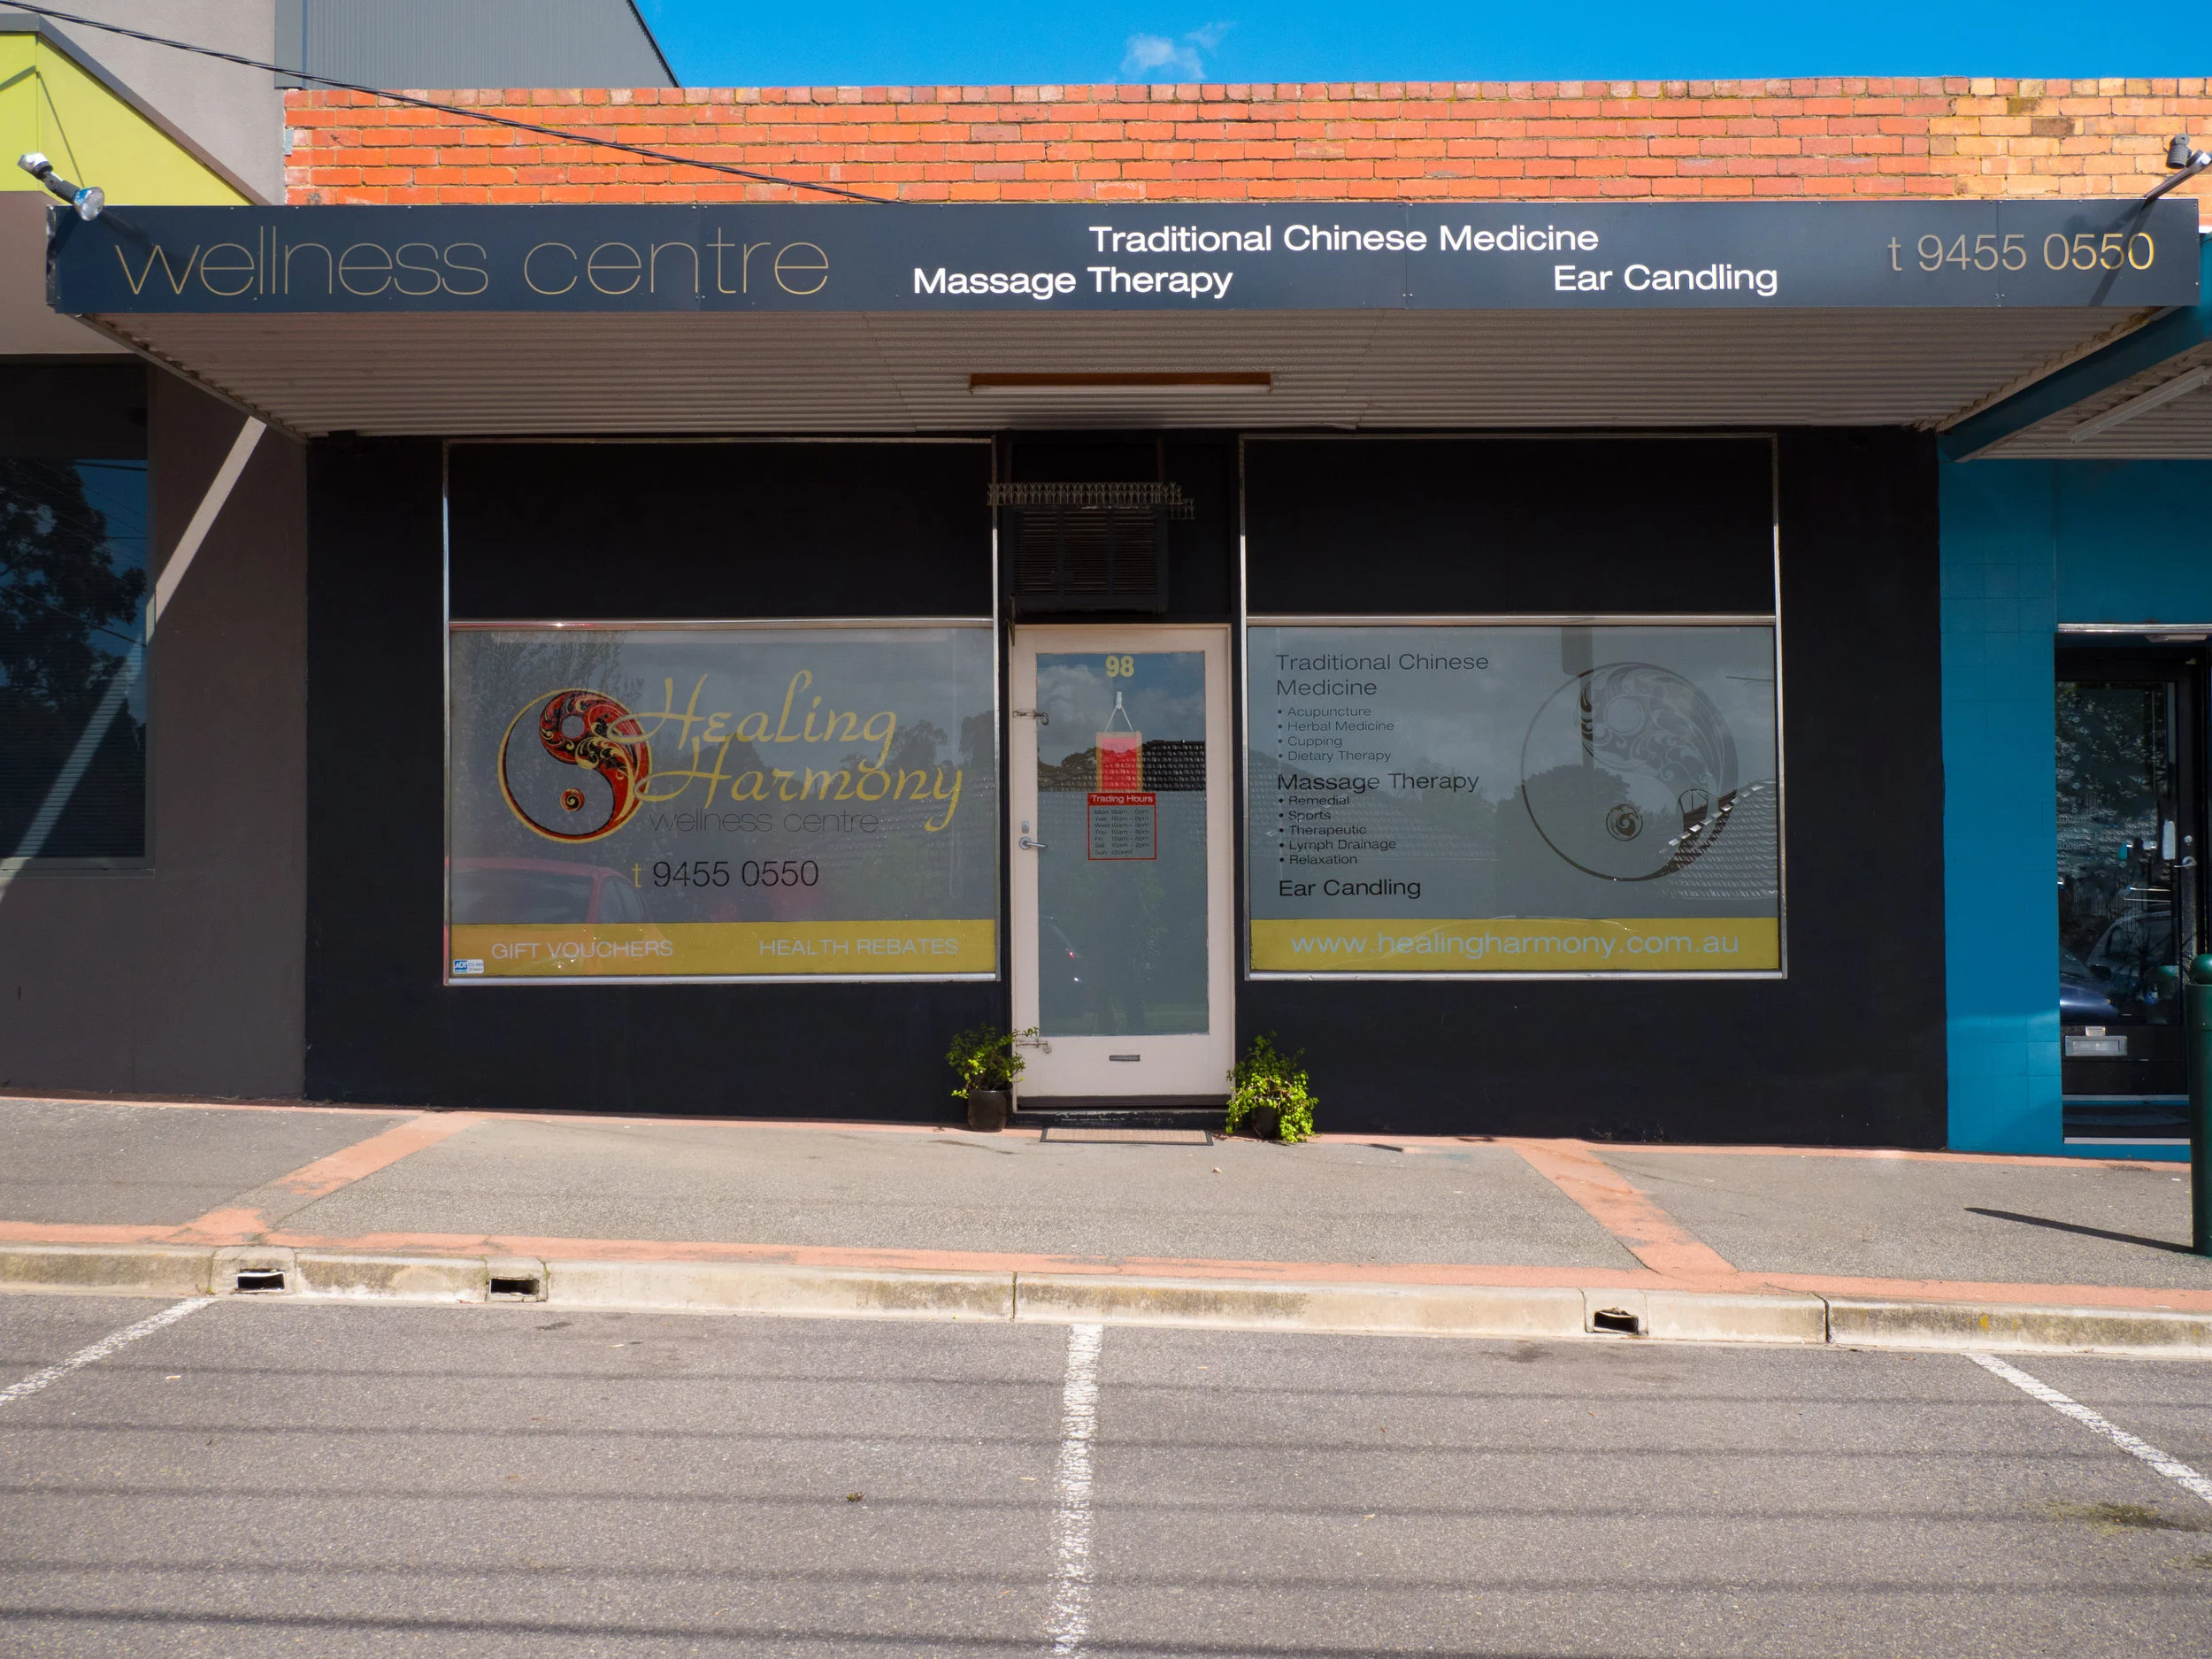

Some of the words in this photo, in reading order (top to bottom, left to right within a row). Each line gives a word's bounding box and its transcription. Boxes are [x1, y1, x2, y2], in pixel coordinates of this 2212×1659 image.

[1088, 224, 1271, 253] Traditional
[1283, 224, 1428, 252] Chinese
[1439, 224, 1599, 251] Medicine
[114, 225, 489, 296] wellness
[523, 226, 830, 296] centre
[1886, 235, 1902, 272] t
[1916, 233, 2028, 272] 9455
[2041, 233, 2155, 272] 0550
[912, 267, 1077, 300] Massage
[1087, 266, 1233, 299] Therapy
[1554, 265, 1613, 292] Ear
[1623, 263, 1778, 297] Candling
[1105, 655, 1134, 678] 98
[1275, 653, 1392, 671] Traditional
[1398, 652, 1489, 671] Chinese
[1276, 678, 1378, 696] Medicine
[607, 668, 897, 774] Healing
[1287, 706, 1371, 718] Acupuncture
[1287, 720, 1331, 731] Herbal
[1333, 720, 1394, 731] Medicine
[1287, 735, 1343, 749] Cupping
[1287, 750, 1333, 763] Dietary
[1338, 749, 1392, 763] Therapy
[634, 733, 964, 833] Harmony
[1277, 773, 1380, 794] Massage
[1387, 772, 1479, 793] Therapy
[1091, 795, 1125, 804] Trading
[1288, 795, 1349, 805] Remedial
[649, 808, 772, 833] wellness
[783, 809, 879, 833] centre
[1288, 810, 1332, 823] Sports
[1288, 825, 1367, 837] Therapeutic
[1289, 839, 1334, 852] Lymph
[1337, 839, 1396, 851] Drainage
[1289, 854, 1357, 864] Relaxation
[631, 862, 642, 888] t
[652, 859, 730, 888] 9455
[741, 859, 819, 887] 0550
[1279, 879, 1316, 897] Ear
[1323, 879, 1422, 900] Candling
[491, 942, 541, 960] GIFT
[547, 940, 673, 959] VOUCHERS
[758, 939, 849, 956] HEALTH
[856, 938, 959, 956] REBATES
[1290, 932, 1740, 959] www.healingharmony.com.au
